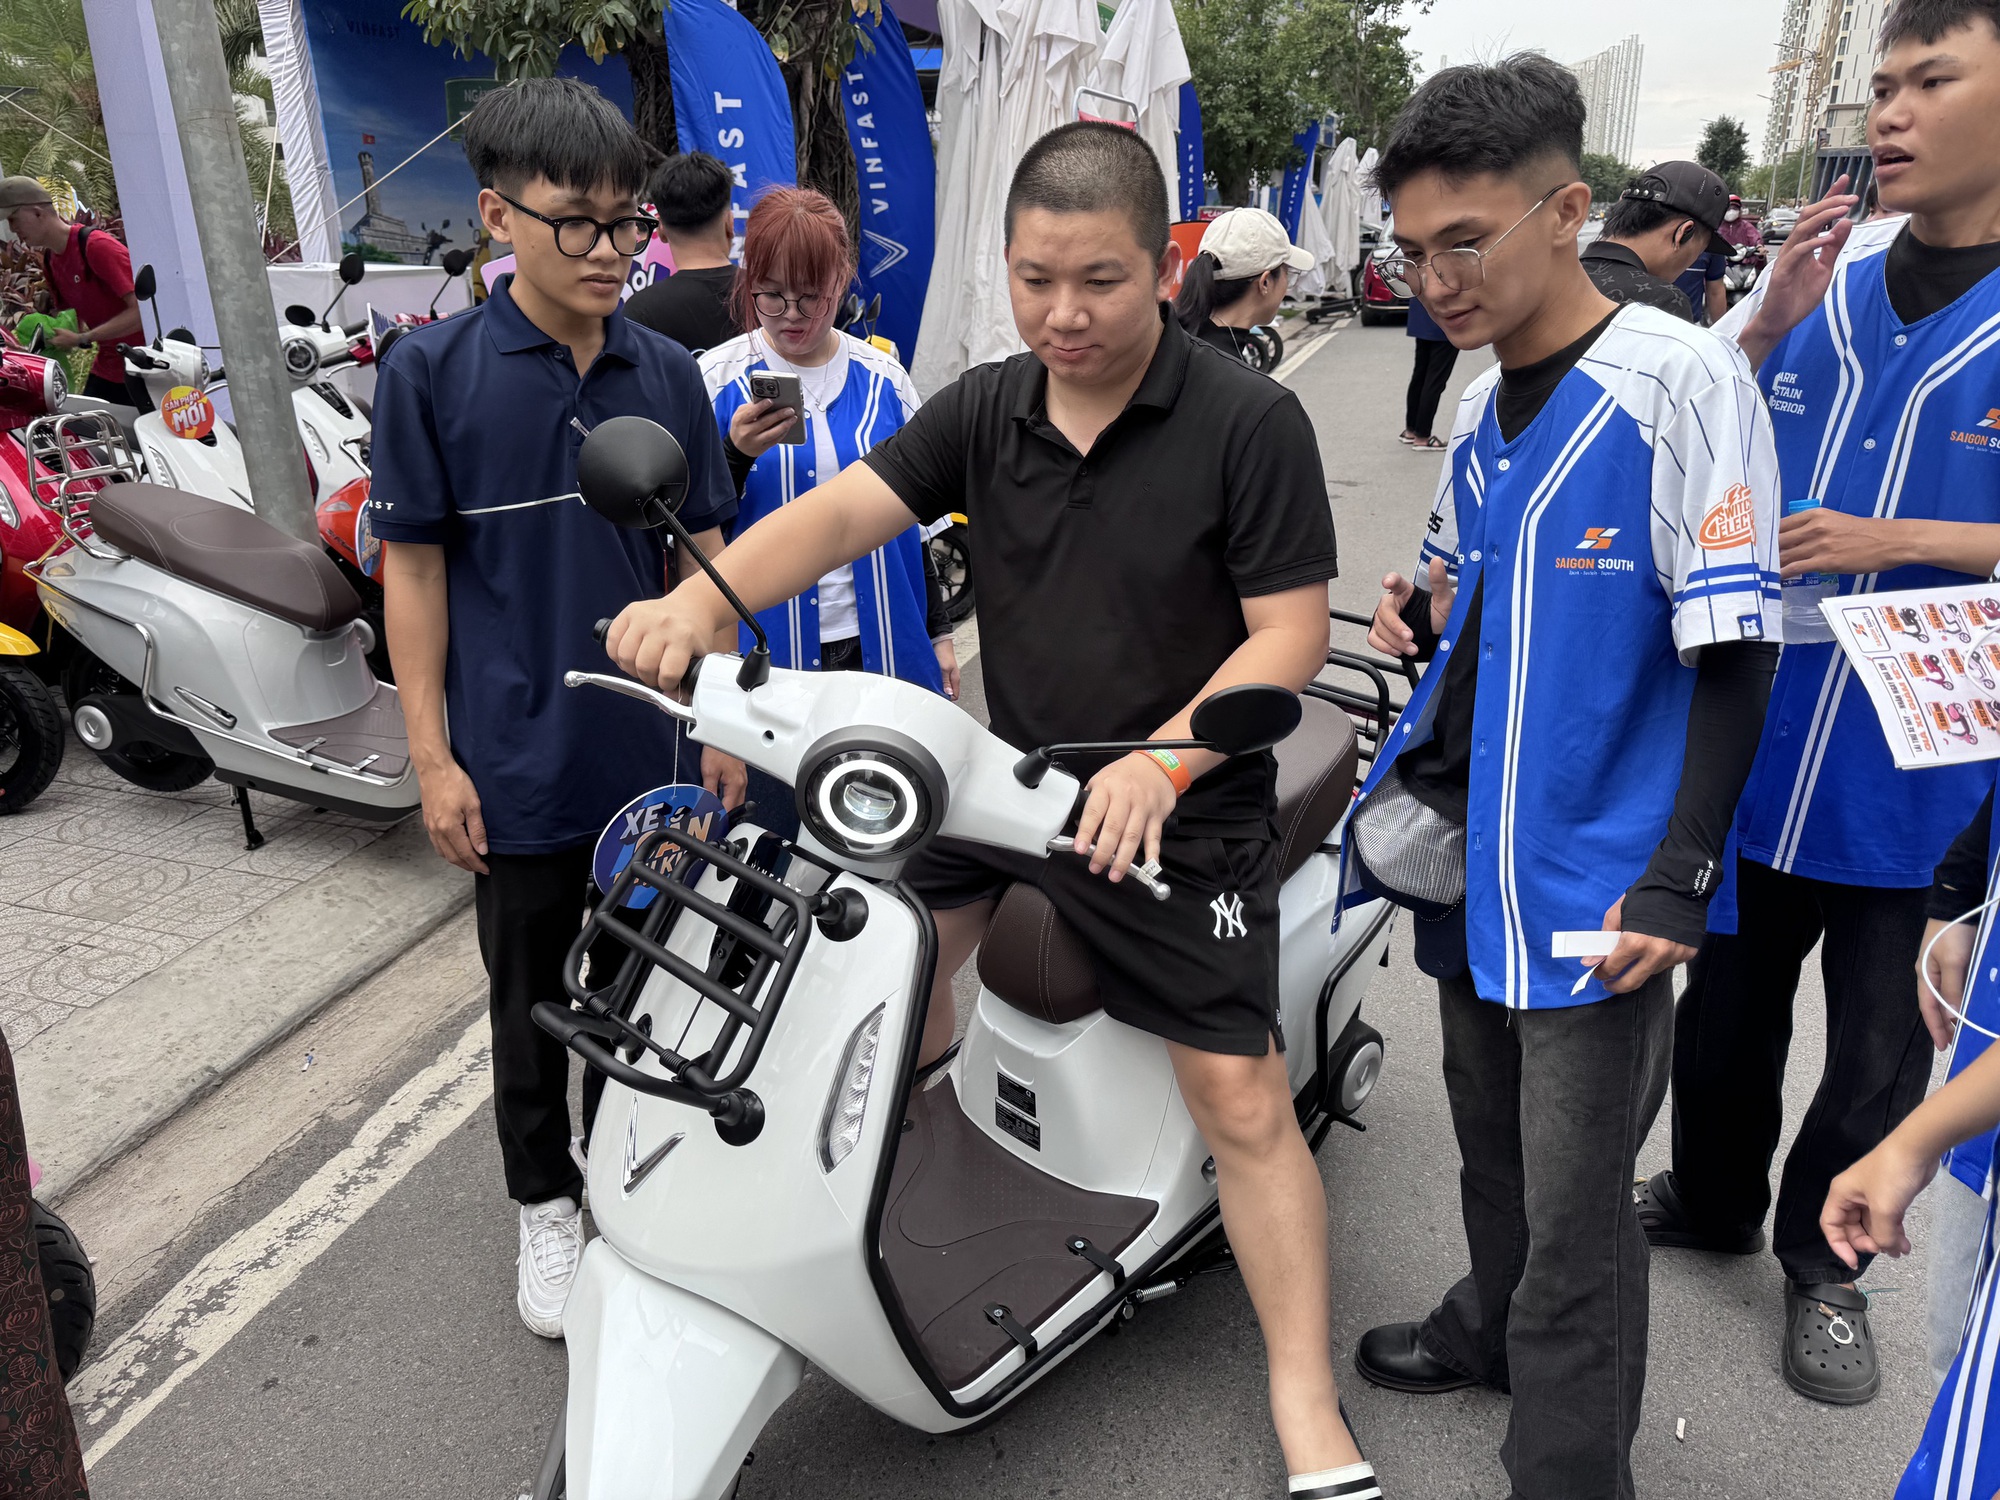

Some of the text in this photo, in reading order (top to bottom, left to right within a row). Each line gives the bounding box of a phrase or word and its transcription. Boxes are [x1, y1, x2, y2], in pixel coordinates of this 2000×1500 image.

[846, 72, 889, 215] VINFAST
[172, 401, 207, 432] MỚI
[1949, 430, 1989, 446] SAIGON
[1555, 557, 1634, 572] SAIGON SOUTH
[1911, 712, 1924, 727] XE
[620, 802, 665, 839] XE
